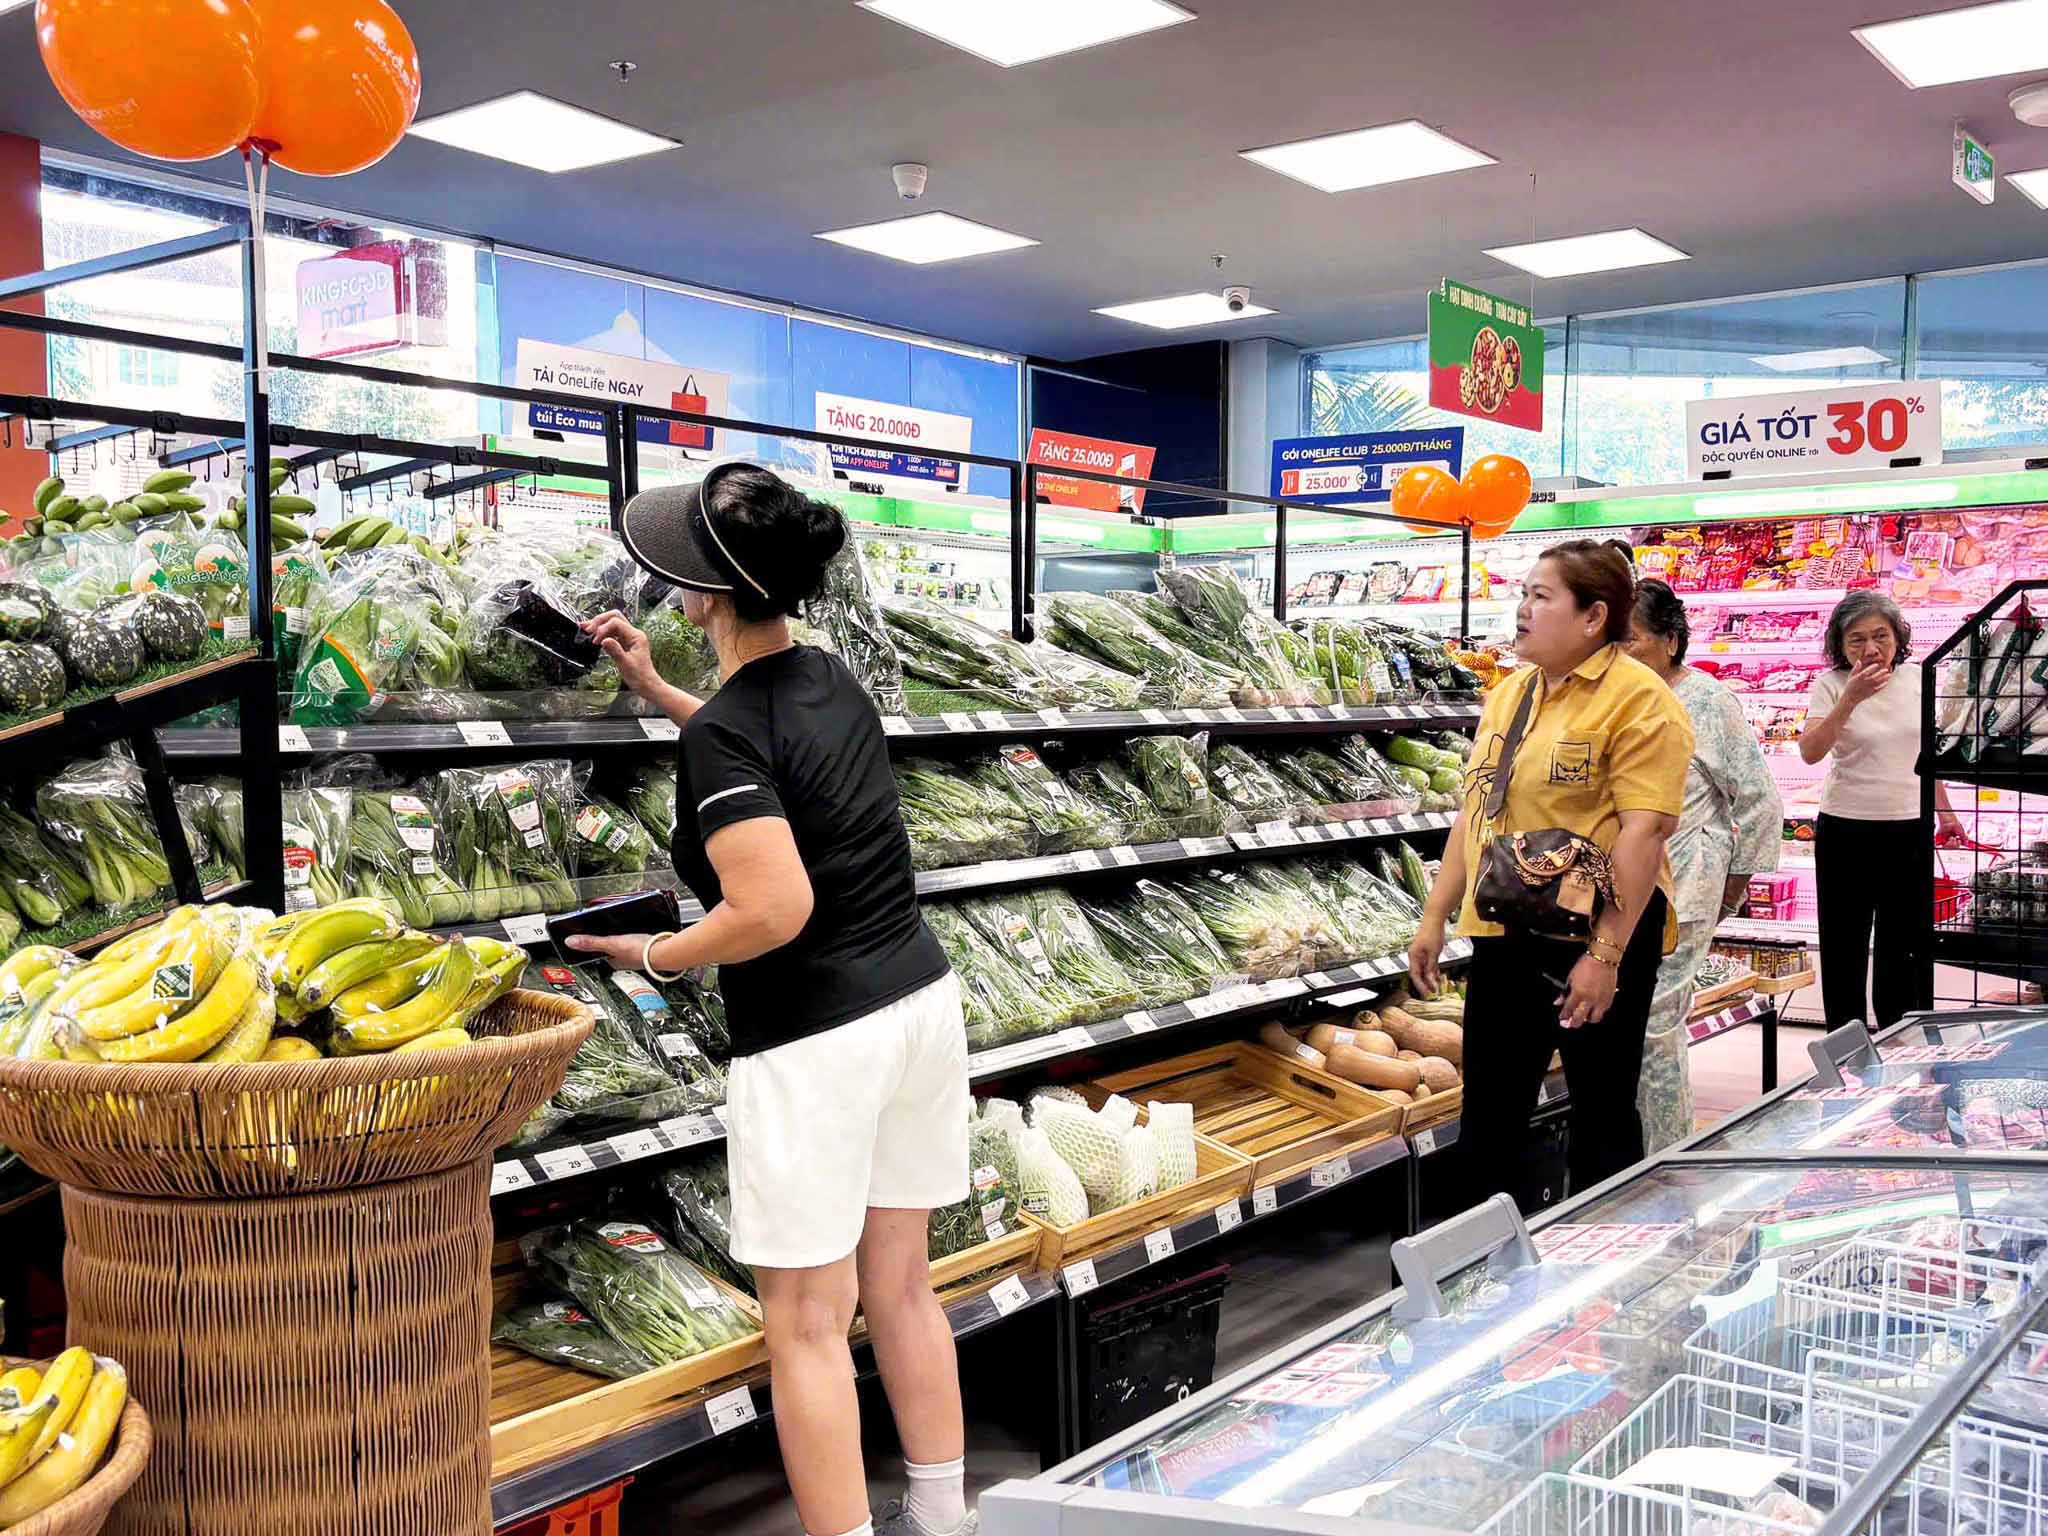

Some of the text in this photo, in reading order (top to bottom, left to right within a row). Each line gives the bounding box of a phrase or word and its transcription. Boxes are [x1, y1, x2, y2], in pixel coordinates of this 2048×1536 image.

[533, 365, 644, 398] TẢI OneLife NGAY
[536, 410, 552, 425] túi
[556, 413, 576, 427] Eco
[578, 418, 603, 432] mua
[826, 405, 921, 439] TẶNG 20.000Đ
[1700, 413, 1751, 446] GIÁ
[1757, 406, 1818, 441] TỐT
[1072, 447, 1115, 468] 25.000Đ
[1282, 447, 1300, 460] GÓI
[1301, 447, 1340, 459] ONELIFE
[1342, 445, 1368, 457] CLUB
[1702, 450, 1726, 464] ĐỘC
[1766, 447, 1806, 459] ONLINE
[534, 927, 544, 936] 19
[506, 1174, 519, 1184] 29
[735, 1406, 745, 1417] 31
